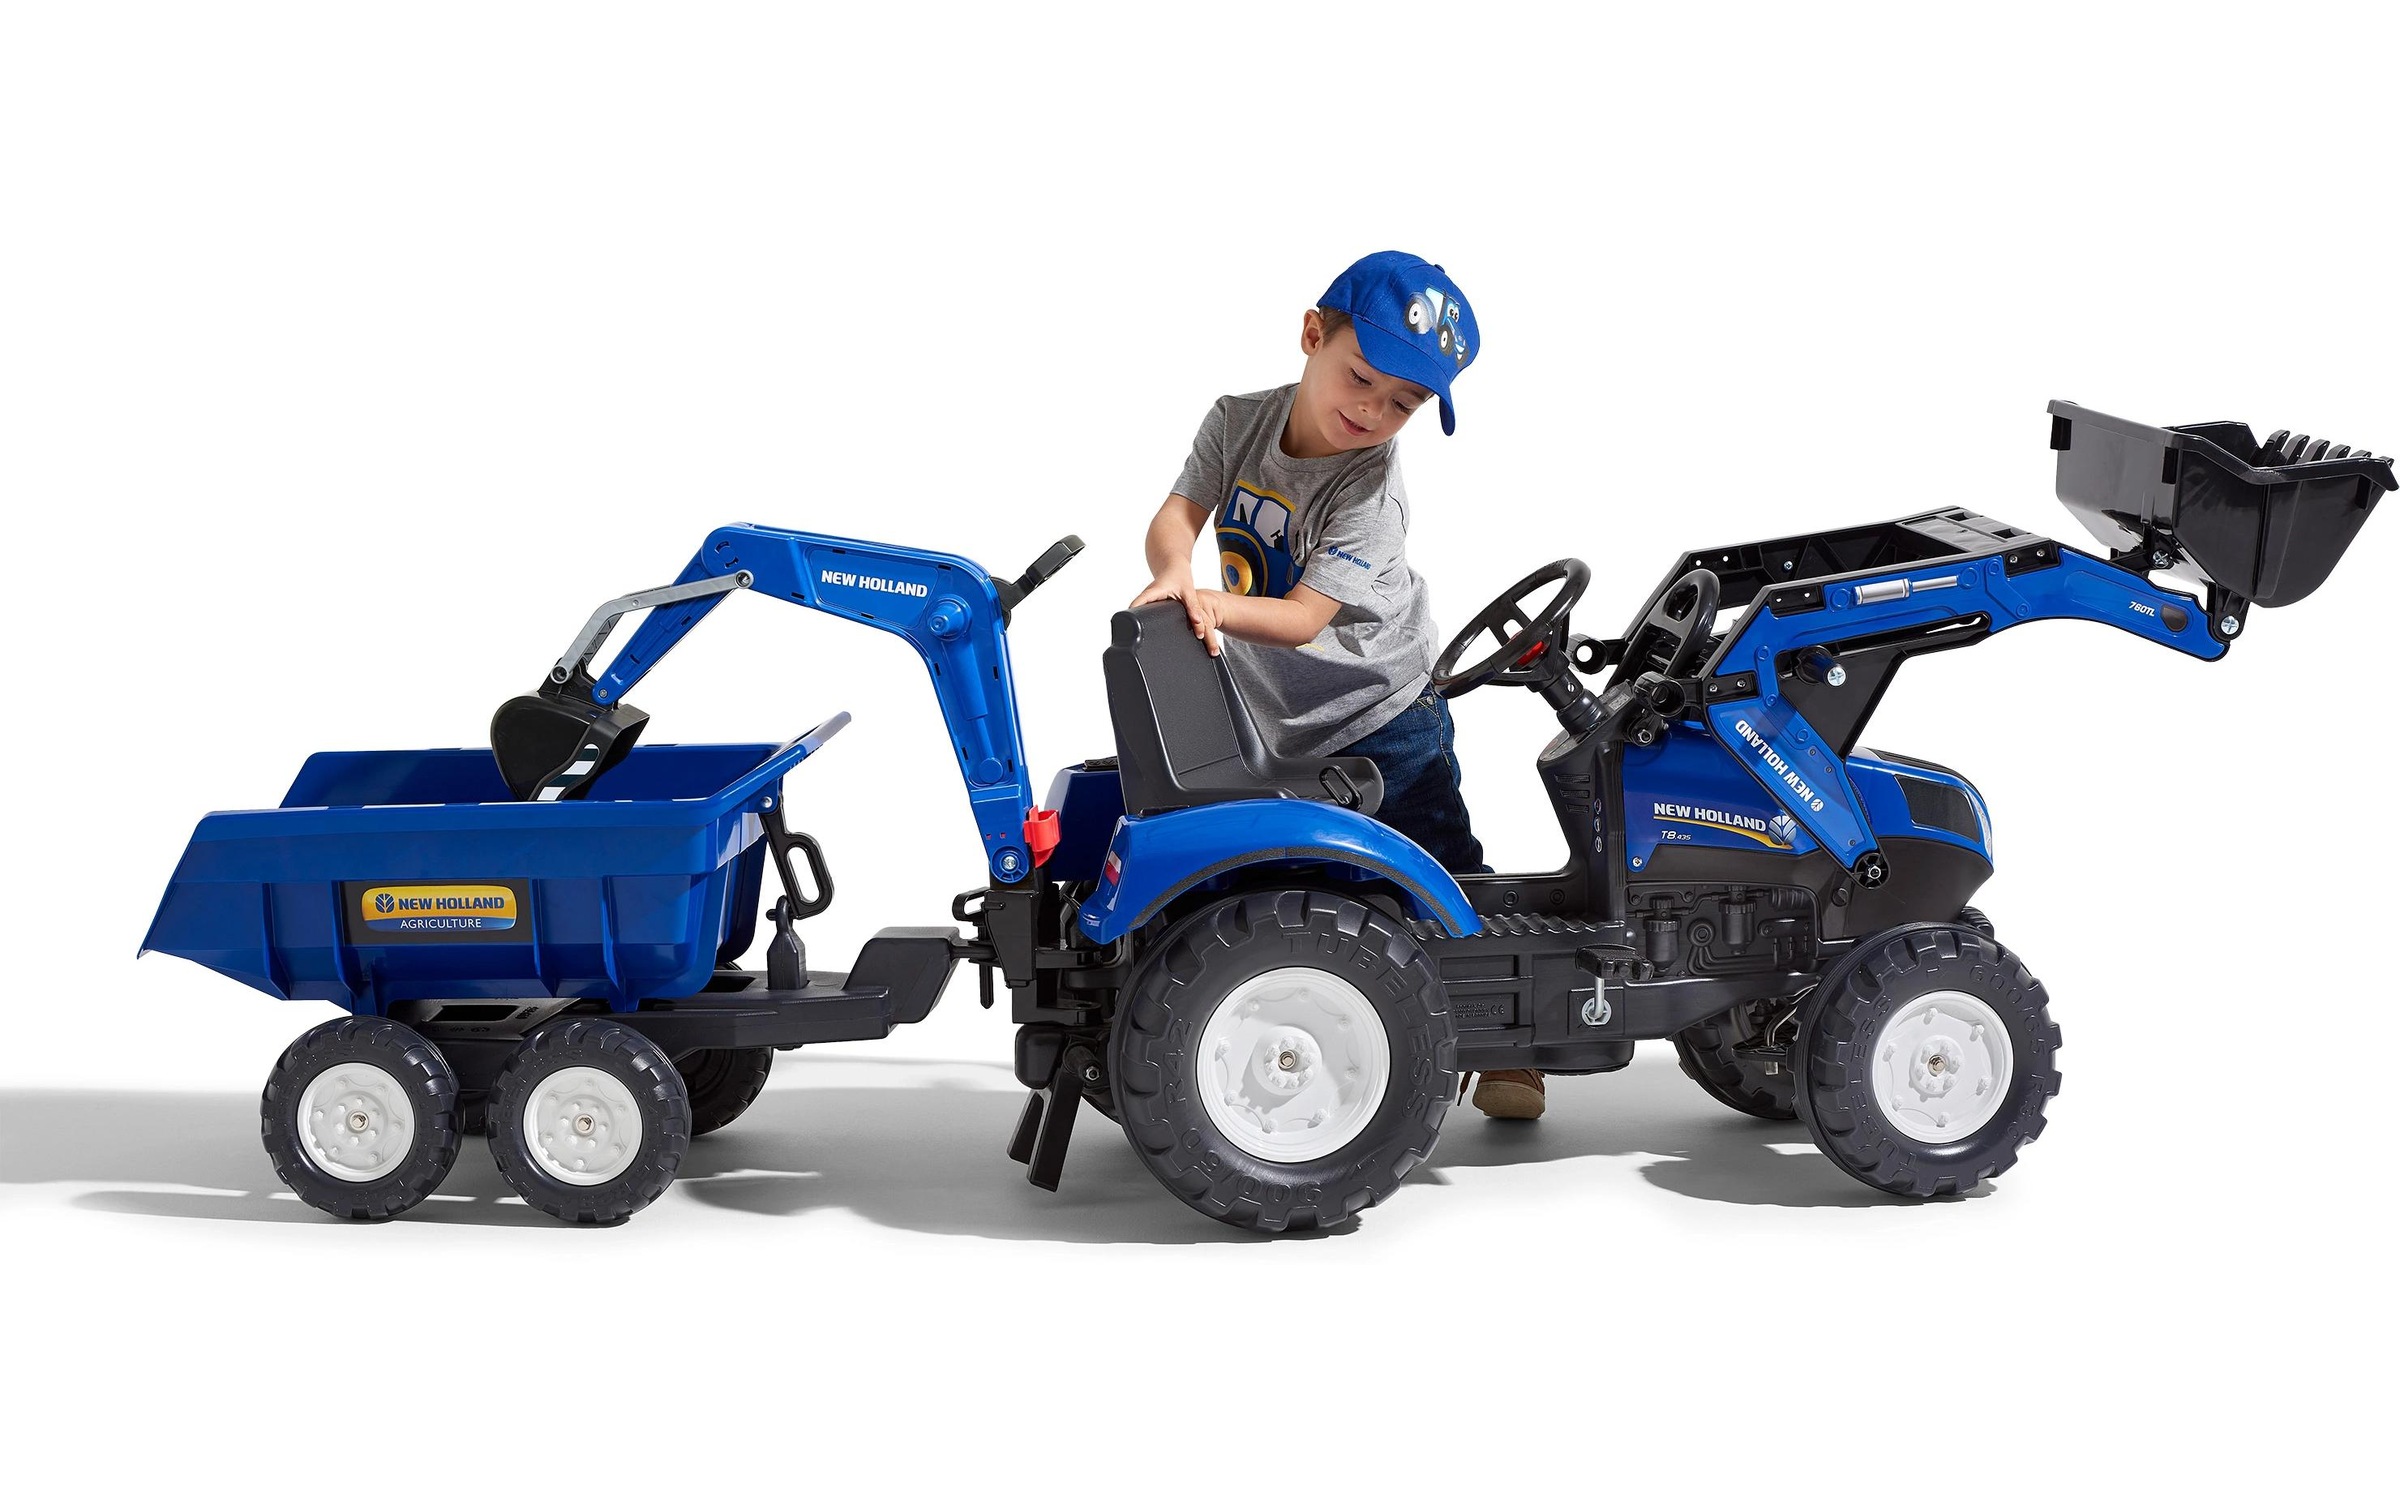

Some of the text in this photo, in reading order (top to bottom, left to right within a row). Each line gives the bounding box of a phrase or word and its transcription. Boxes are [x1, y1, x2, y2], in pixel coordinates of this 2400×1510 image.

[1337, 551, 1353, 561] NEW
[821, 569, 928, 598] NEW HOLLAND
[1735, 719, 1815, 803] NEW HOLLAND
[1653, 802, 1767, 832] NEW HOLLAND
[1661, 830, 1692, 841] T8.435
[398, 896, 505, 911] NEW HOLLAND
[400, 918, 482, 929] AGRICULTURE
[1282, 931, 1433, 1119] TUBELESS
